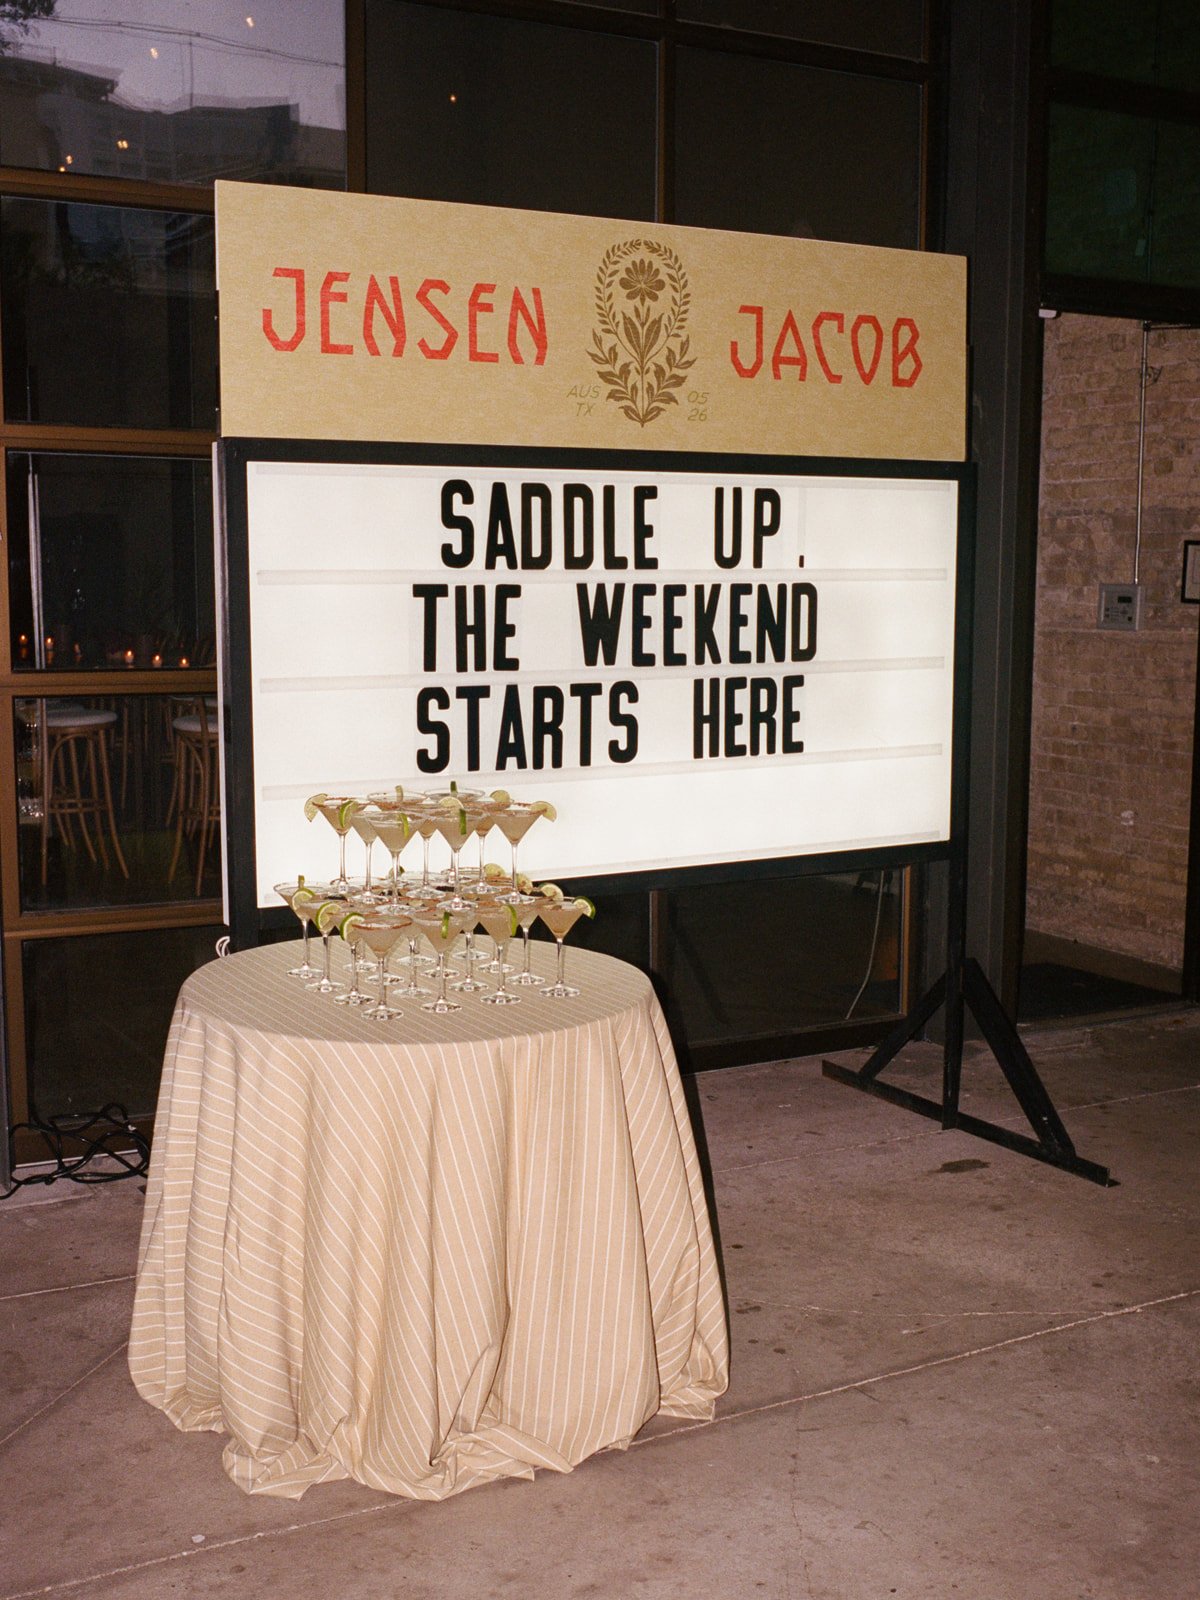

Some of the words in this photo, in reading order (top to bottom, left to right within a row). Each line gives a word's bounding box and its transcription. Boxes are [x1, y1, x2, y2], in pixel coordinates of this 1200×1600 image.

[262, 268, 547, 365] JENSEN
[730, 306, 922, 387] JACOB
[566, 385, 601, 399] AUS
[575, 402, 596, 417] TX
[687, 408, 708, 422] 26
[441, 480, 658, 570] SADDLE
[714, 487, 805, 569] UP.
[413, 584, 521, 673] THE
[576, 583, 817, 667] WEEKEND
[416, 681, 638, 773] STARTS
[694, 675, 804, 759] HERE
